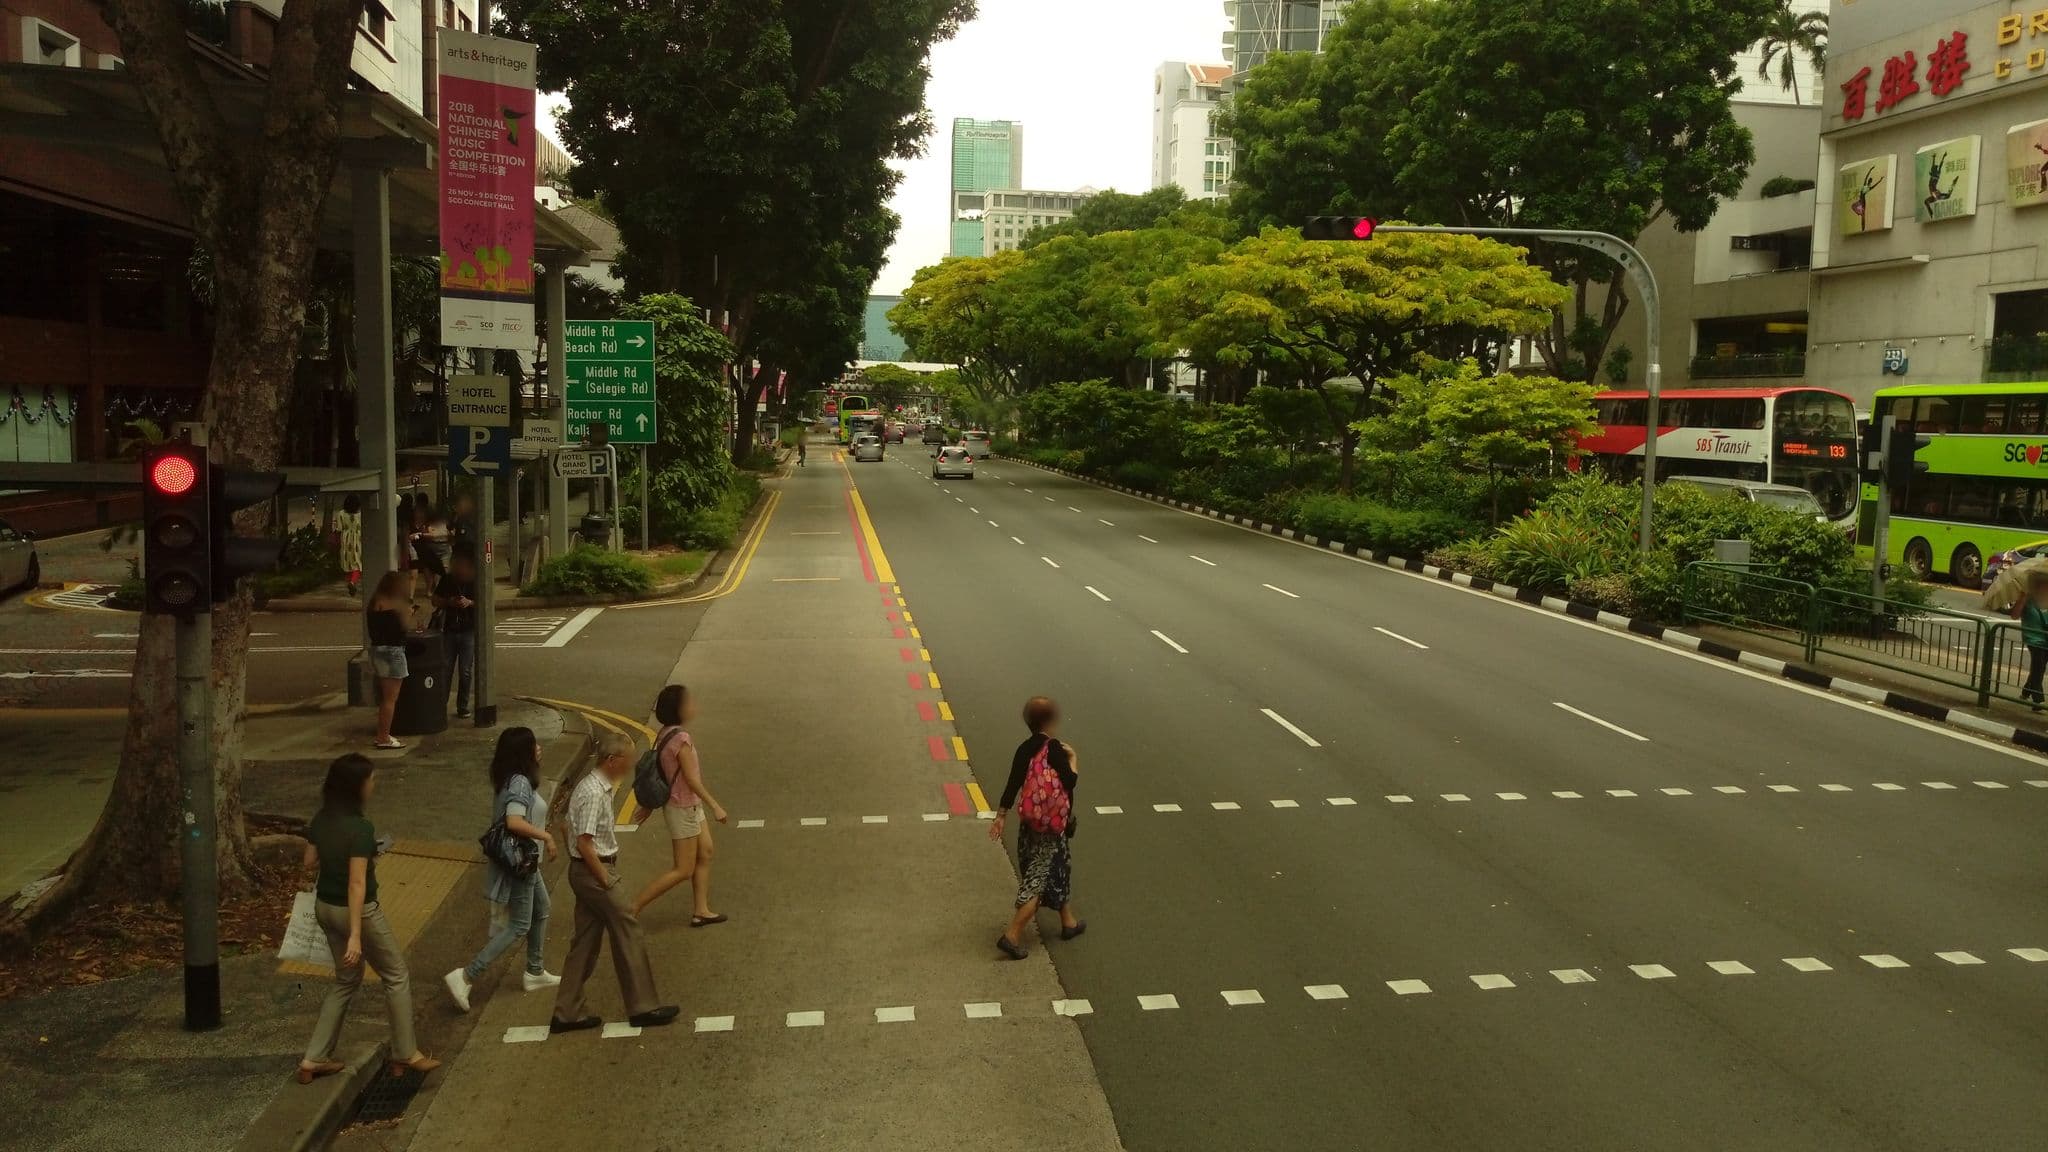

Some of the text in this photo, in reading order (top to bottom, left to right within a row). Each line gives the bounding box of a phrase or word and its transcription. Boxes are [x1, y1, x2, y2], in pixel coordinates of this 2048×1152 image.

[448, 101, 474, 113] 2018
[448, 112, 506, 130] NATIONAL
[448, 125, 499, 140] CHINESE
[448, 136, 486, 150] MUSIC
[448, 148, 526, 167] COMPETITION
[457, 189, 474, 197] NOV
[484, 192, 498, 200] DEC
[498, 194, 515, 202] 2018
[463, 198, 498, 208] CONCERT
[497, 202, 515, 210] HALL
[565, 325, 615, 337] Middle Rd
[601, 341, 618, 353] Rd)
[585, 366, 637, 378] Middle Rd
[462, 388, 496, 398] HOTEL
[586, 381, 648, 396] (Selegie Rd)
[450, 403, 508, 415] ENTRANCE
[567, 408, 622, 419] Rochor Rd
[609, 424, 623, 436] Rd
[469, 427, 491, 454] P
[525, 435, 559, 443] ENTRANCE
[1695, 435, 1752, 456] SBS Transit
[1830, 445, 1845, 458] 133
